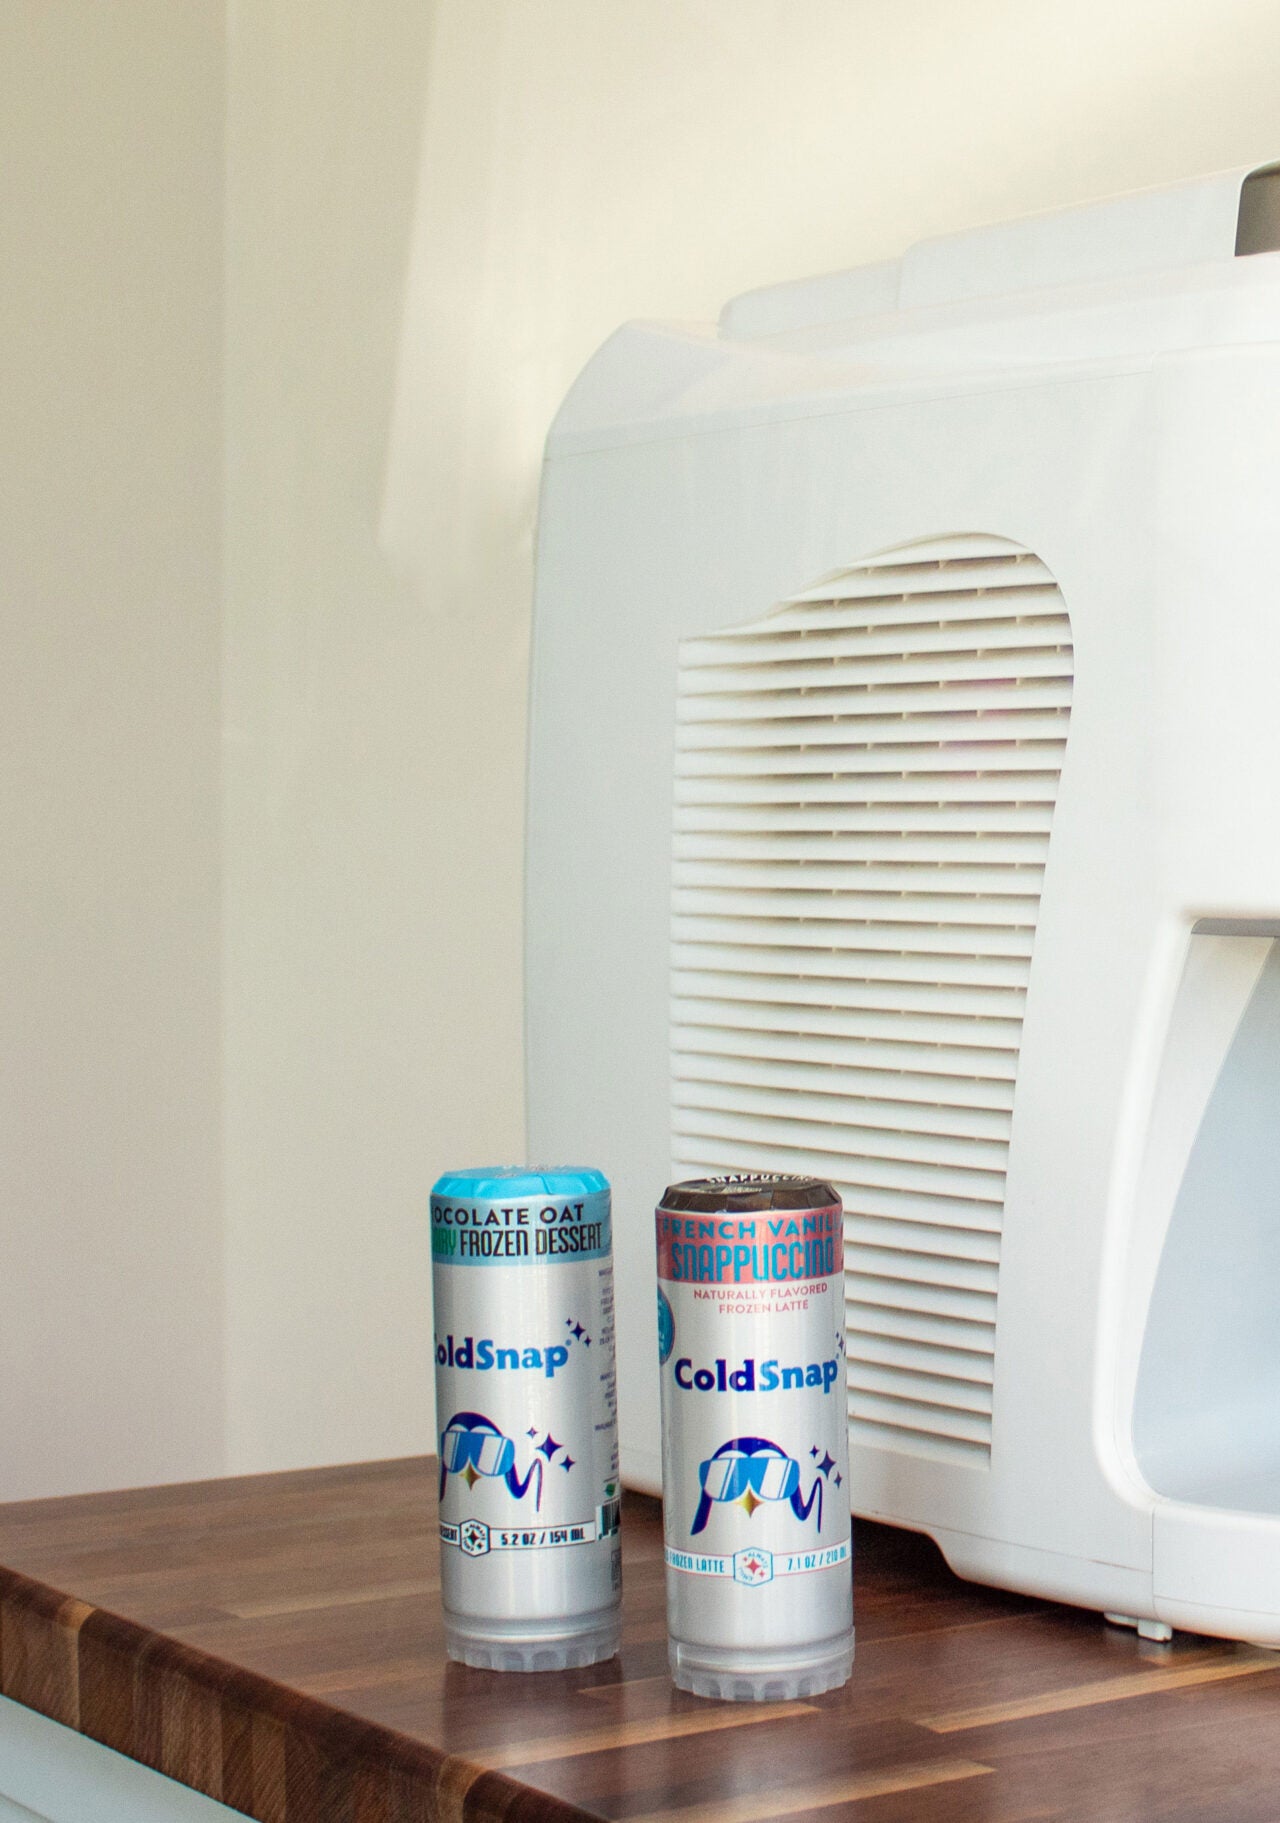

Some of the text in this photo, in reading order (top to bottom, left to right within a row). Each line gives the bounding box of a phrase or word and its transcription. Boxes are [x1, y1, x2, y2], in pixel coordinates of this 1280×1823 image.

[431, 1204, 584, 1226] OCOLATE OAT
[664, 1217, 756, 1239] FRENCH
[460, 1229, 529, 1257] FROZEN
[535, 1222, 602, 1256] DESSERT
[671, 1236, 834, 1282] SNAPPUCCINO
[694, 1282, 828, 1300] NATURALLY FLAVORED
[719, 1300, 809, 1314] FROZEN LATTE
[435, 1335, 569, 1378] oldSnap
[674, 1357, 838, 1394] ColdSnap
[522, 1532, 536, 1546] OZ
[550, 1529, 568, 1544] 154
[696, 1557, 725, 1573] LATTE
[804, 1553, 816, 1568] OZ
